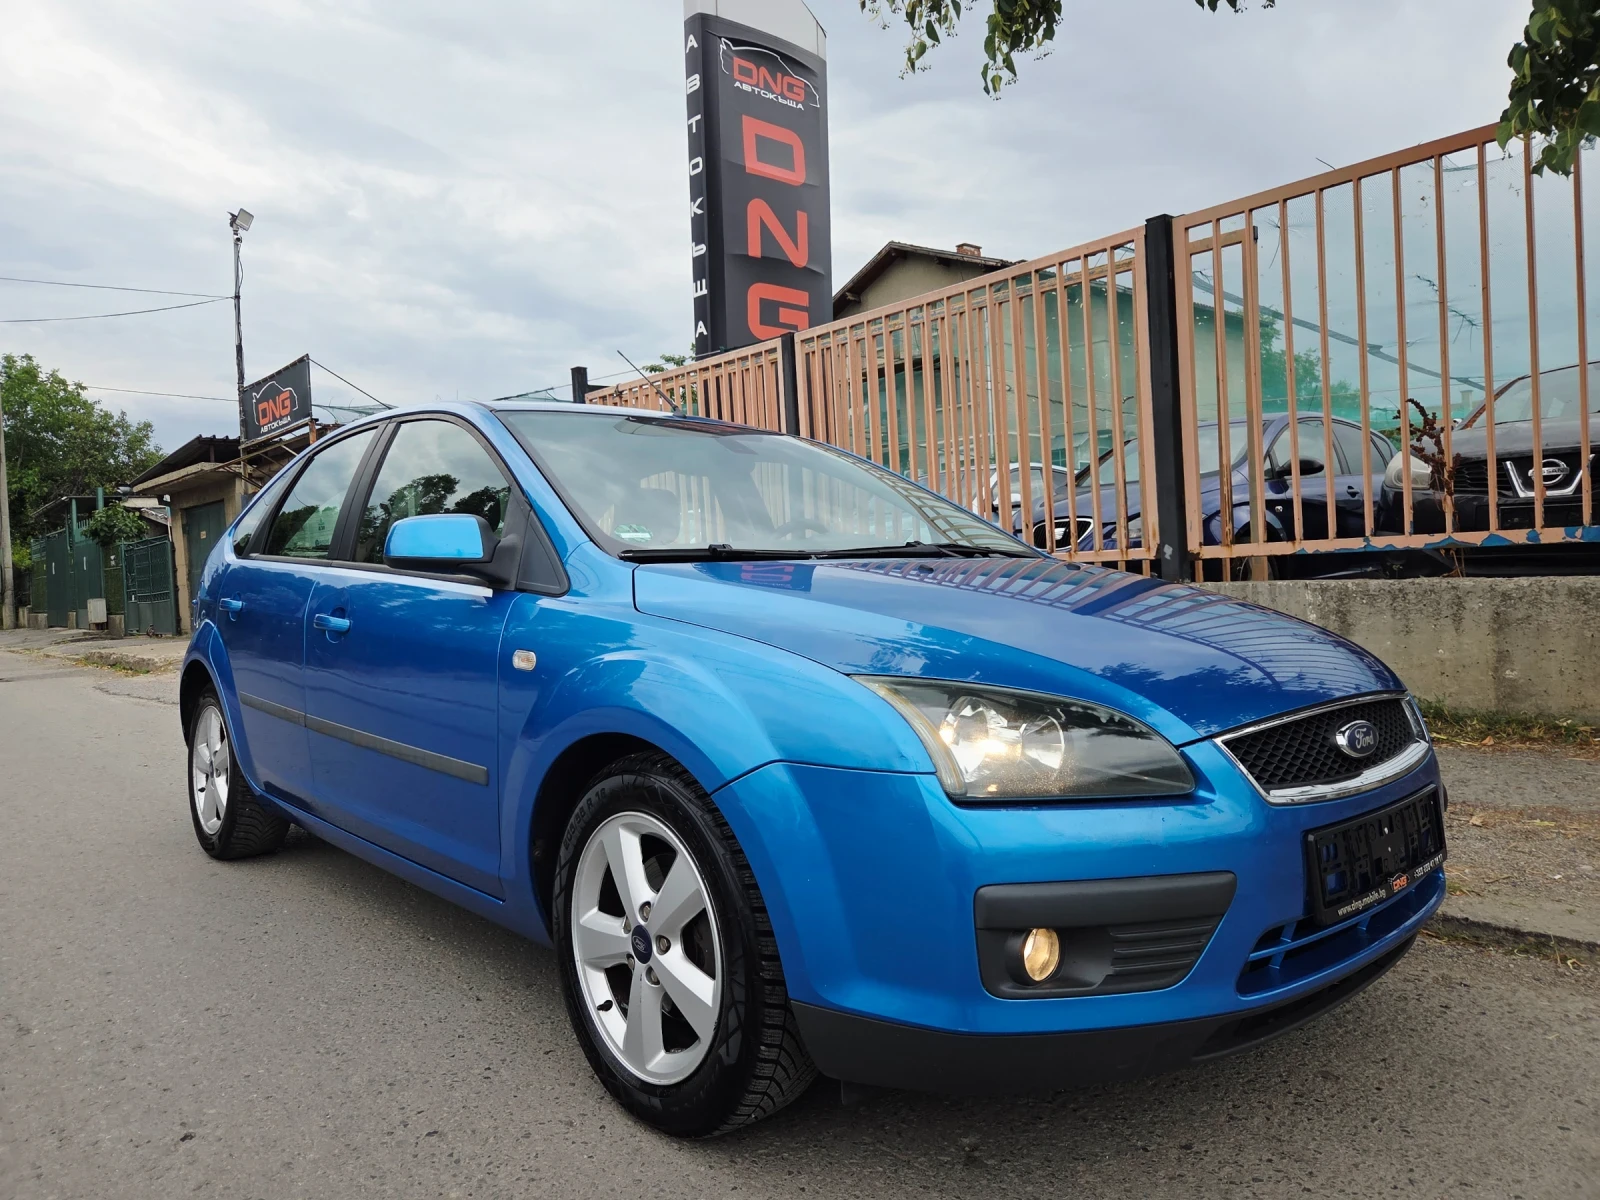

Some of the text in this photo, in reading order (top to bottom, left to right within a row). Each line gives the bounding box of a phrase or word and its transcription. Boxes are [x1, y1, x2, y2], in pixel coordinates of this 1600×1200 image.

[732, 56, 805, 102] DNG
[734, 81, 804, 110] АВТОКЪША
[742, 114, 809, 340] DNG
[258, 390, 291, 426] DNG
[1355, 727, 1374, 749] Ford
[1392, 875, 1407, 890] DNG
[1337, 888, 1386, 916] www.dng.mobile.bg
